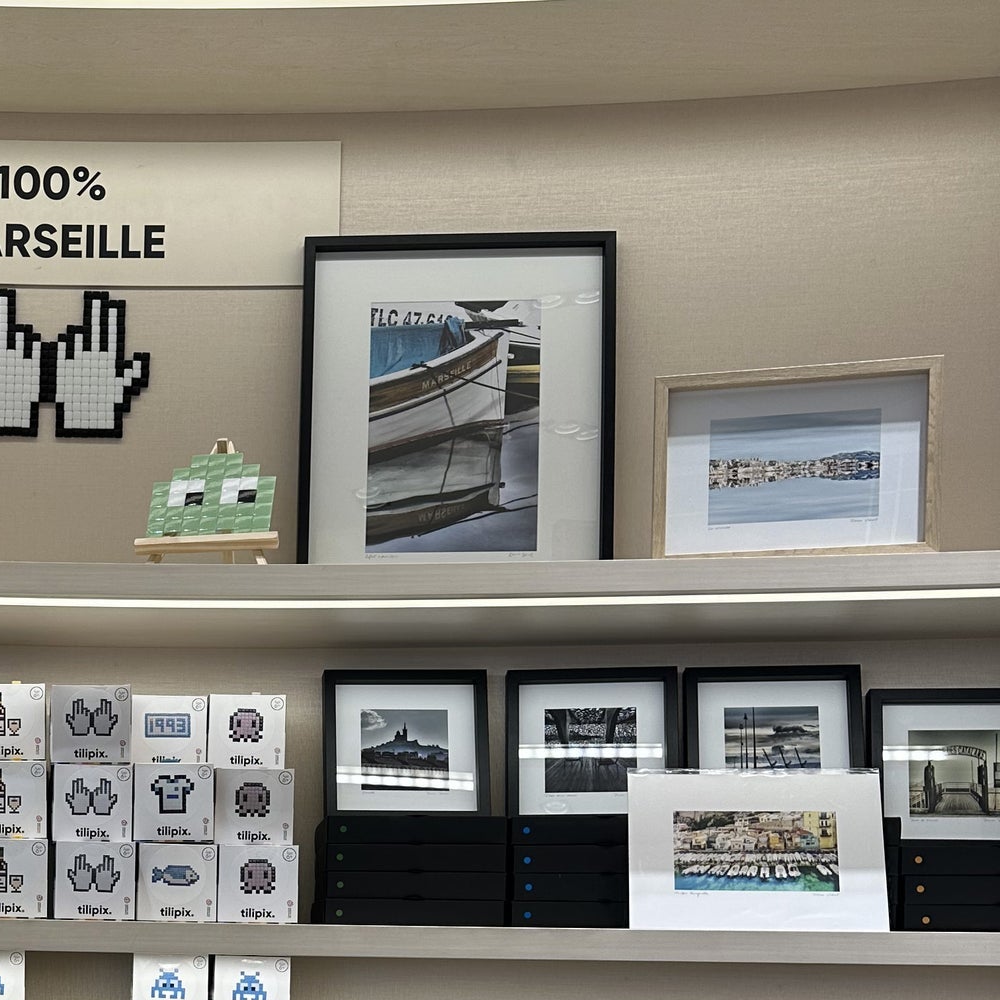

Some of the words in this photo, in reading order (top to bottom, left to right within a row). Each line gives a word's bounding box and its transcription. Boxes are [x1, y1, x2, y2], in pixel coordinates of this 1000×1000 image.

[149, 718, 186, 733] 1993
[74, 749, 108, 760] tilipix.
[230, 755, 262, 766] tilipix.
[76, 828, 109, 839] tilipix.
[157, 826, 191, 838] tilipix.
[237, 831, 270, 842] tilipix.
[78, 905, 111, 916] tilipix.
[160, 907, 194, 919] tilipix.
[241, 908, 275, 920] tilipix.
